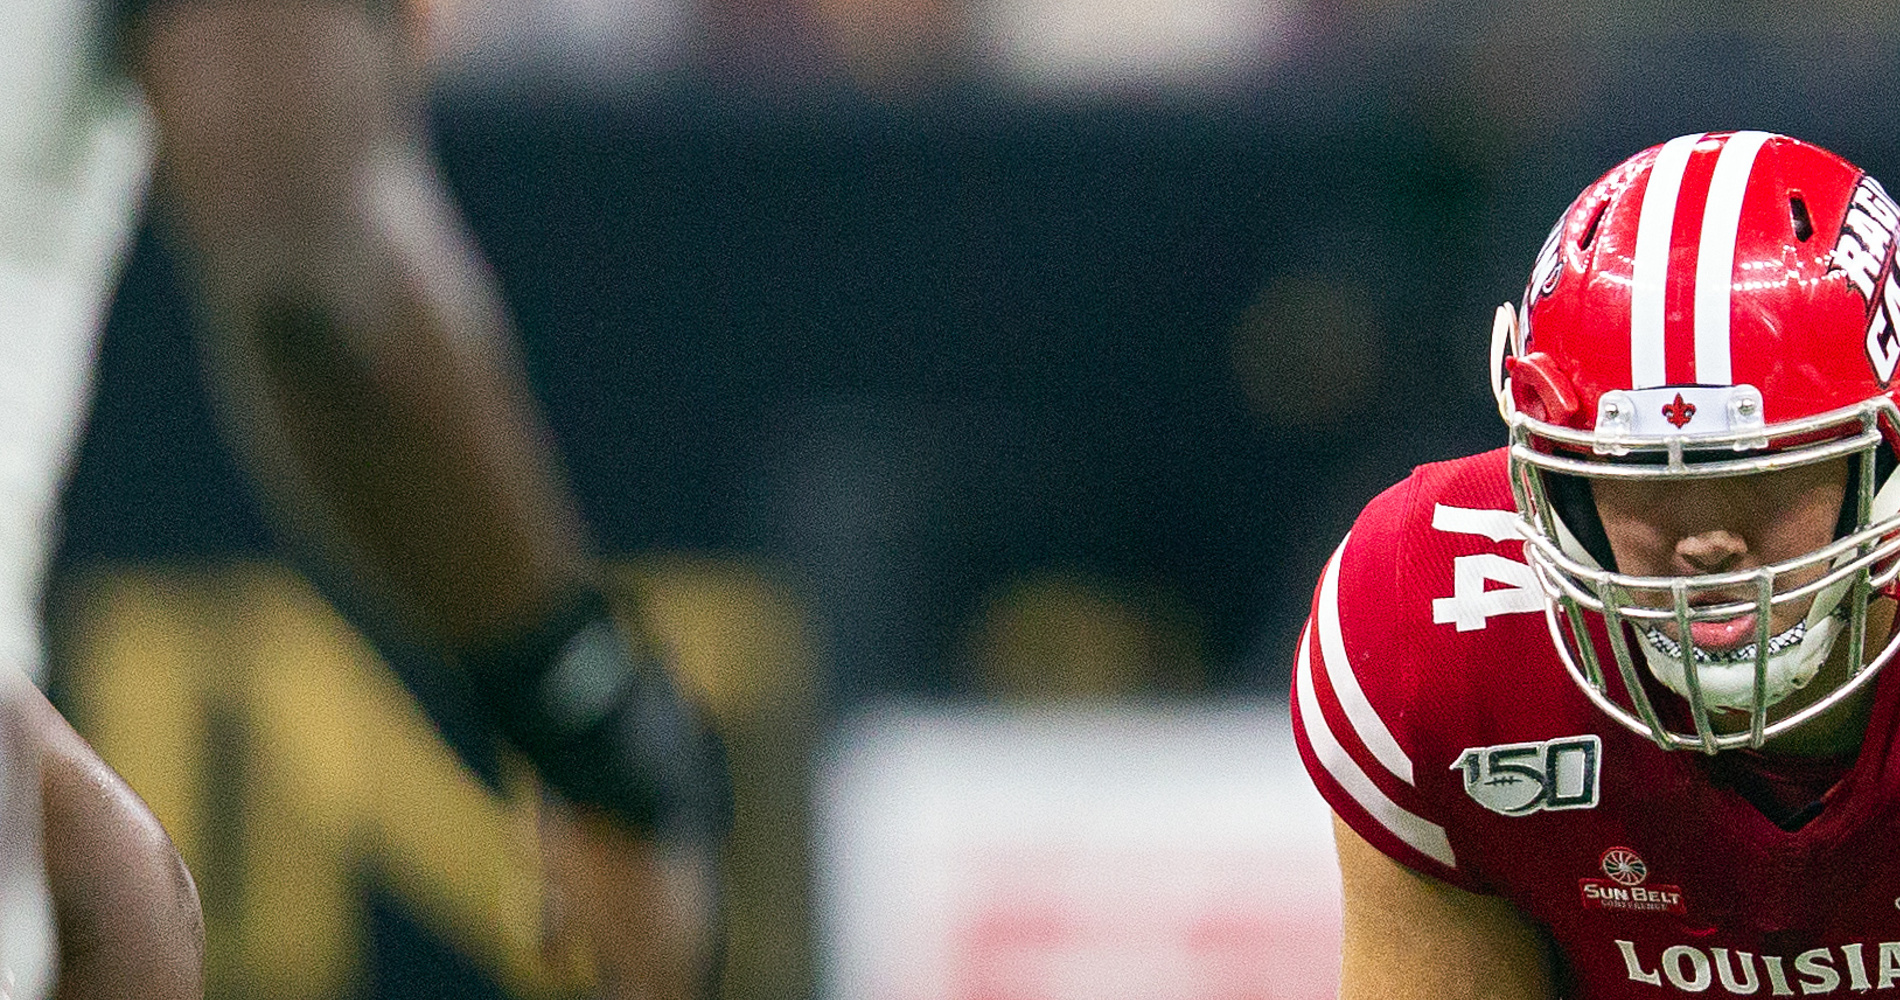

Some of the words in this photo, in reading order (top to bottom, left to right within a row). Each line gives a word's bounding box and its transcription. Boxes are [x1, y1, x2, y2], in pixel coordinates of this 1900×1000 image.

[1450, 735, 1602, 817] 150
[1583, 884, 1630, 901] SUN
[1631, 887, 1681, 905] BELT
